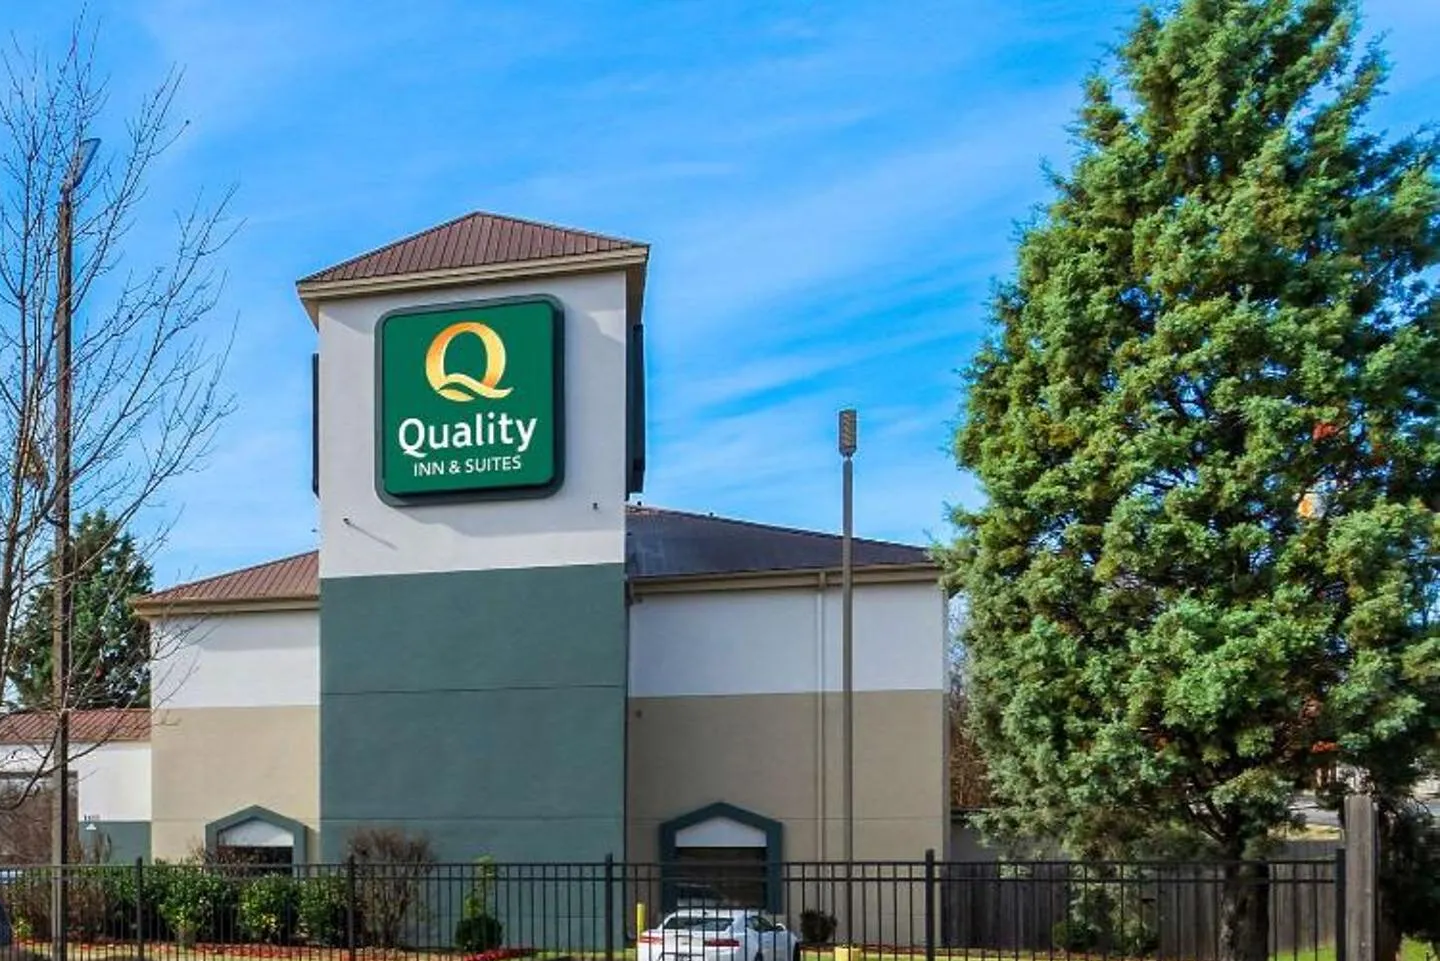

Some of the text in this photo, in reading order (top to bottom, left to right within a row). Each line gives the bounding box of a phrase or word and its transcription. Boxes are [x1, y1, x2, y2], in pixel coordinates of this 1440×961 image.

[425, 321, 514, 402] Q
[398, 412, 538, 458] Quality
[414, 455, 522, 477] INN & SUITES
